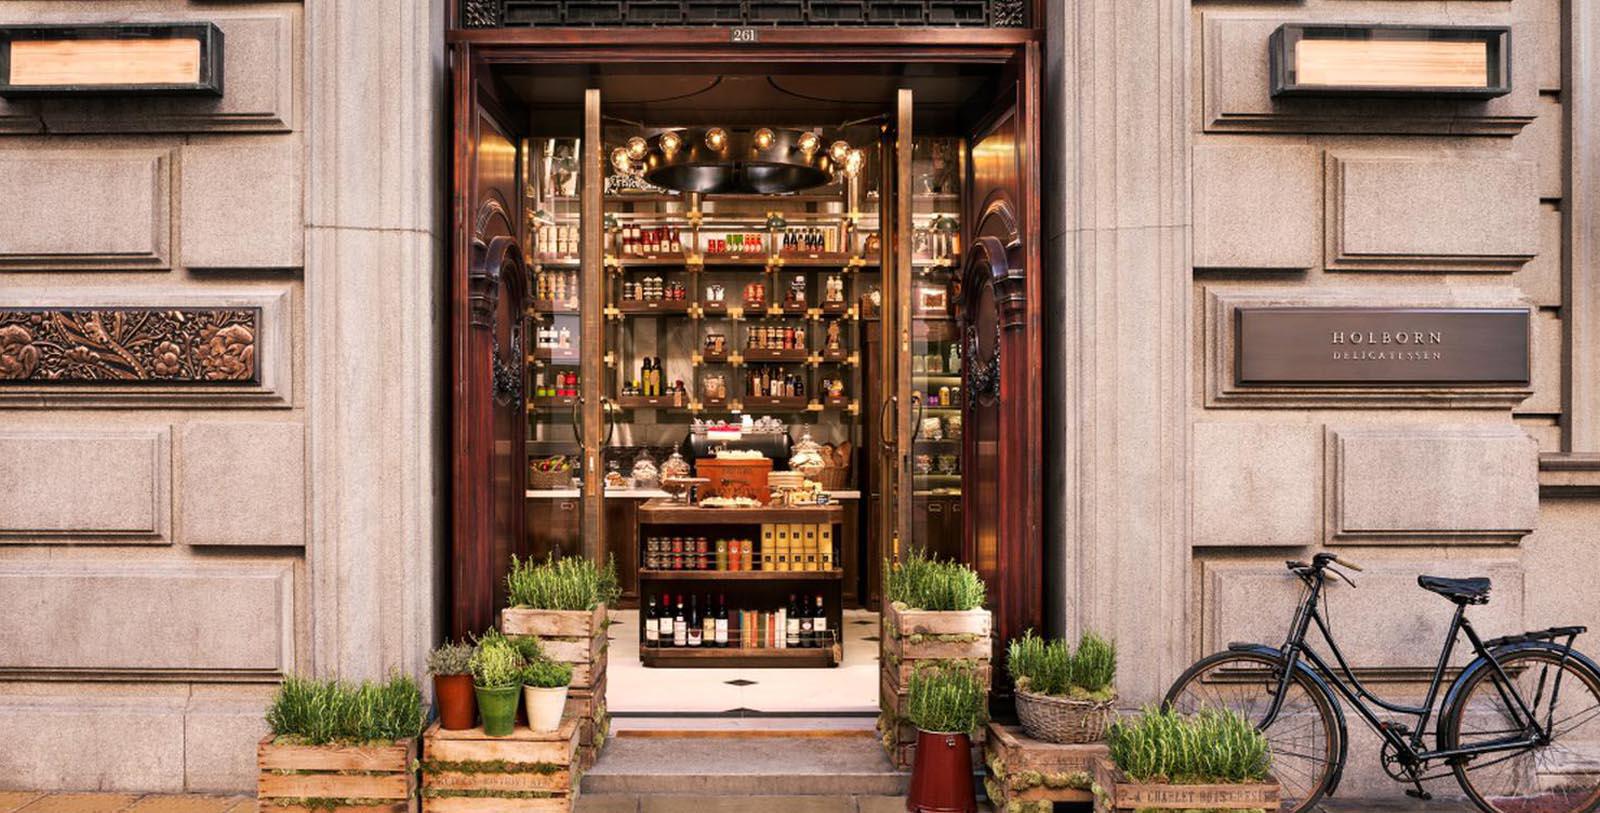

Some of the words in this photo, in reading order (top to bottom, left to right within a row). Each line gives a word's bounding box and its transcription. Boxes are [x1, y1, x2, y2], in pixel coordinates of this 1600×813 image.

[733, 29, 755, 41] 261
[1332, 331, 1442, 344] HOLBORN
[1332, 351, 1442, 361] DELICATESSEN
